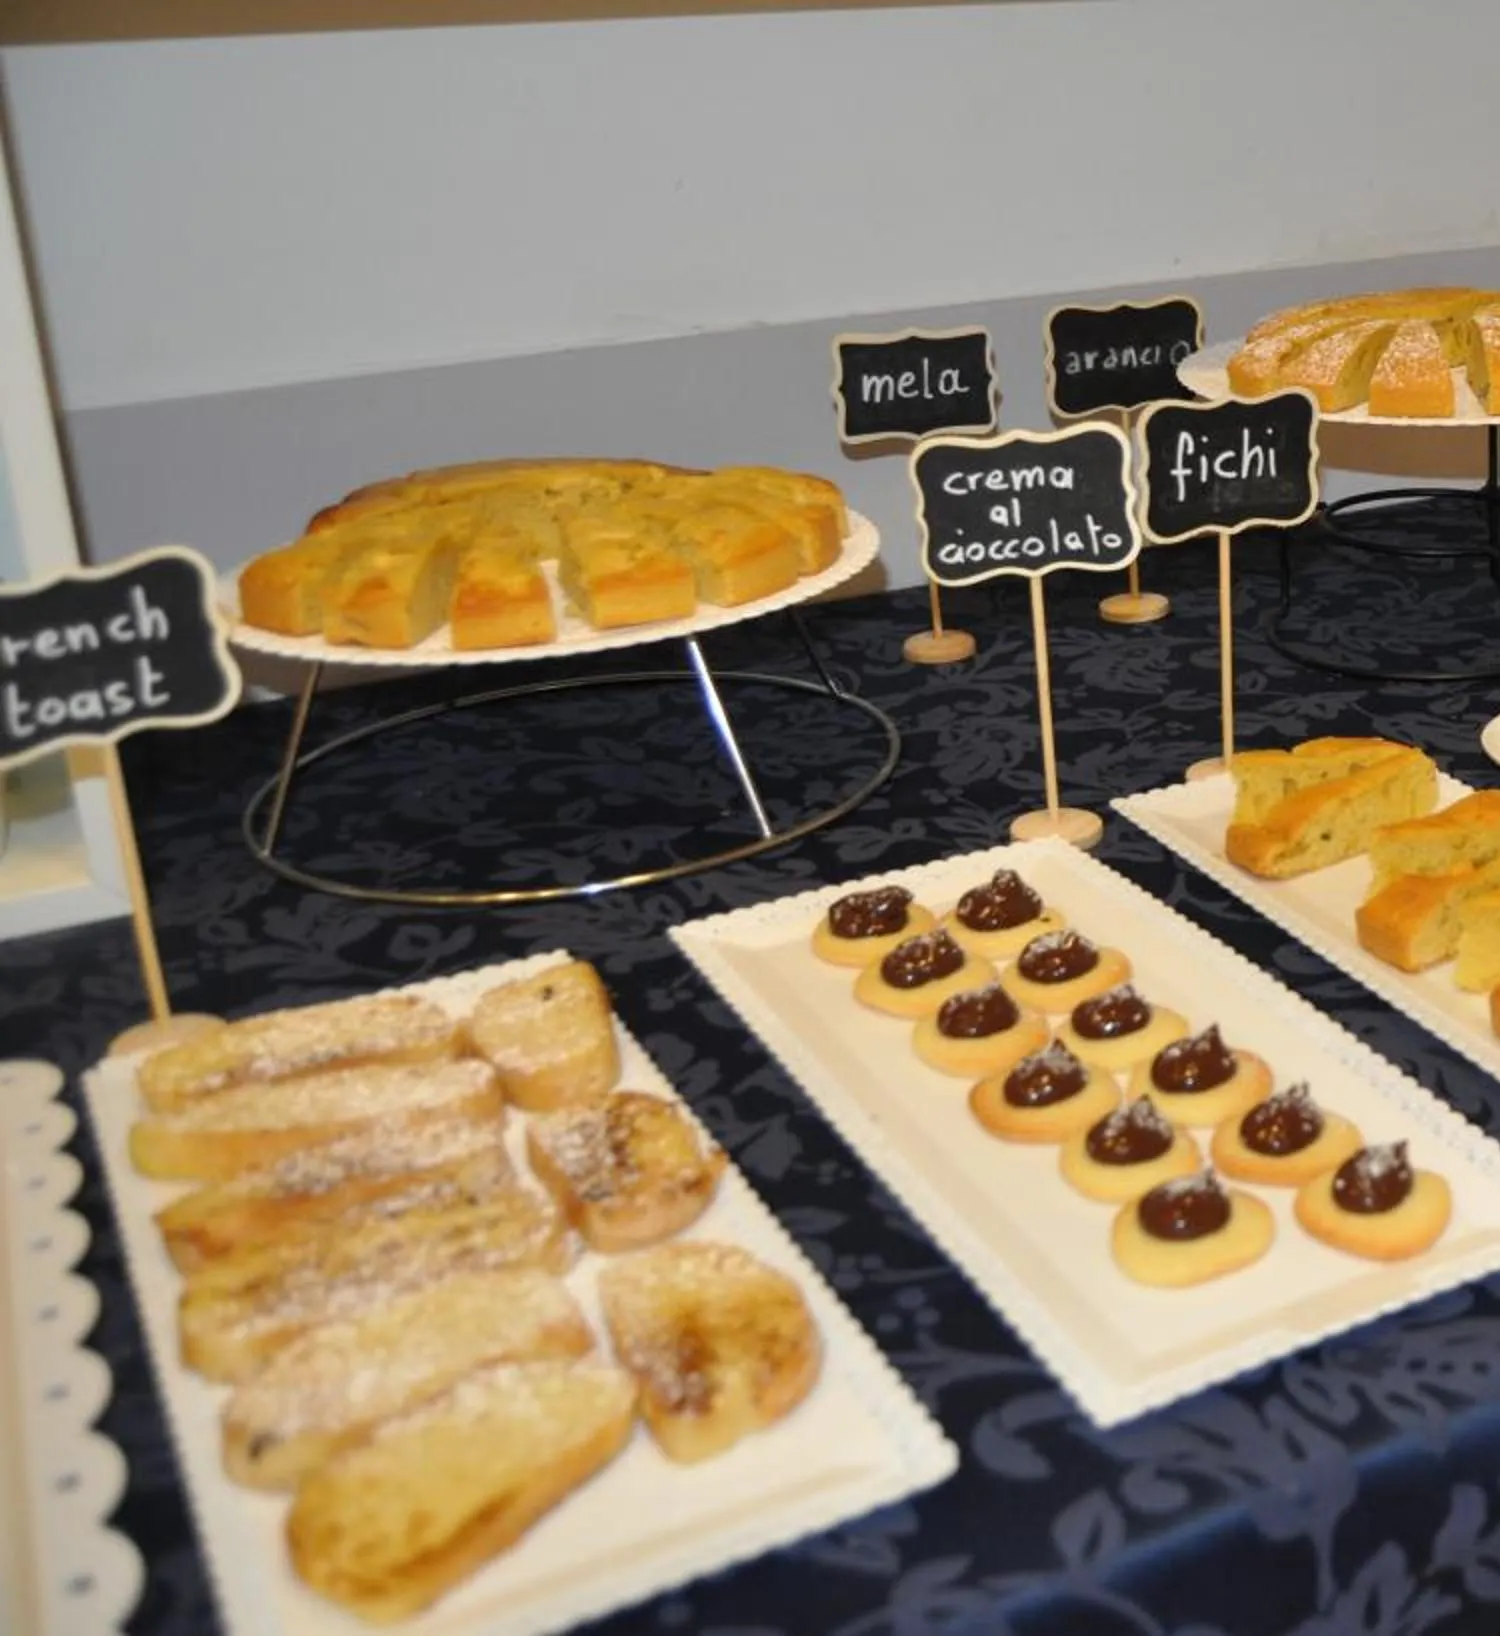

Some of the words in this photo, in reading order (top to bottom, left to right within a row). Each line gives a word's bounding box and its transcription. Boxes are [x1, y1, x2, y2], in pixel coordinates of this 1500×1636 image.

[862, 357, 970, 403] mela
[1065, 340, 1191, 375] arancio
[943, 465, 1074, 495] crema
[1170, 418, 1277, 502] fichi
[989, 497, 1021, 527] al
[938, 513, 1123, 564] cioccolato
[6, 655, 171, 738] toast
